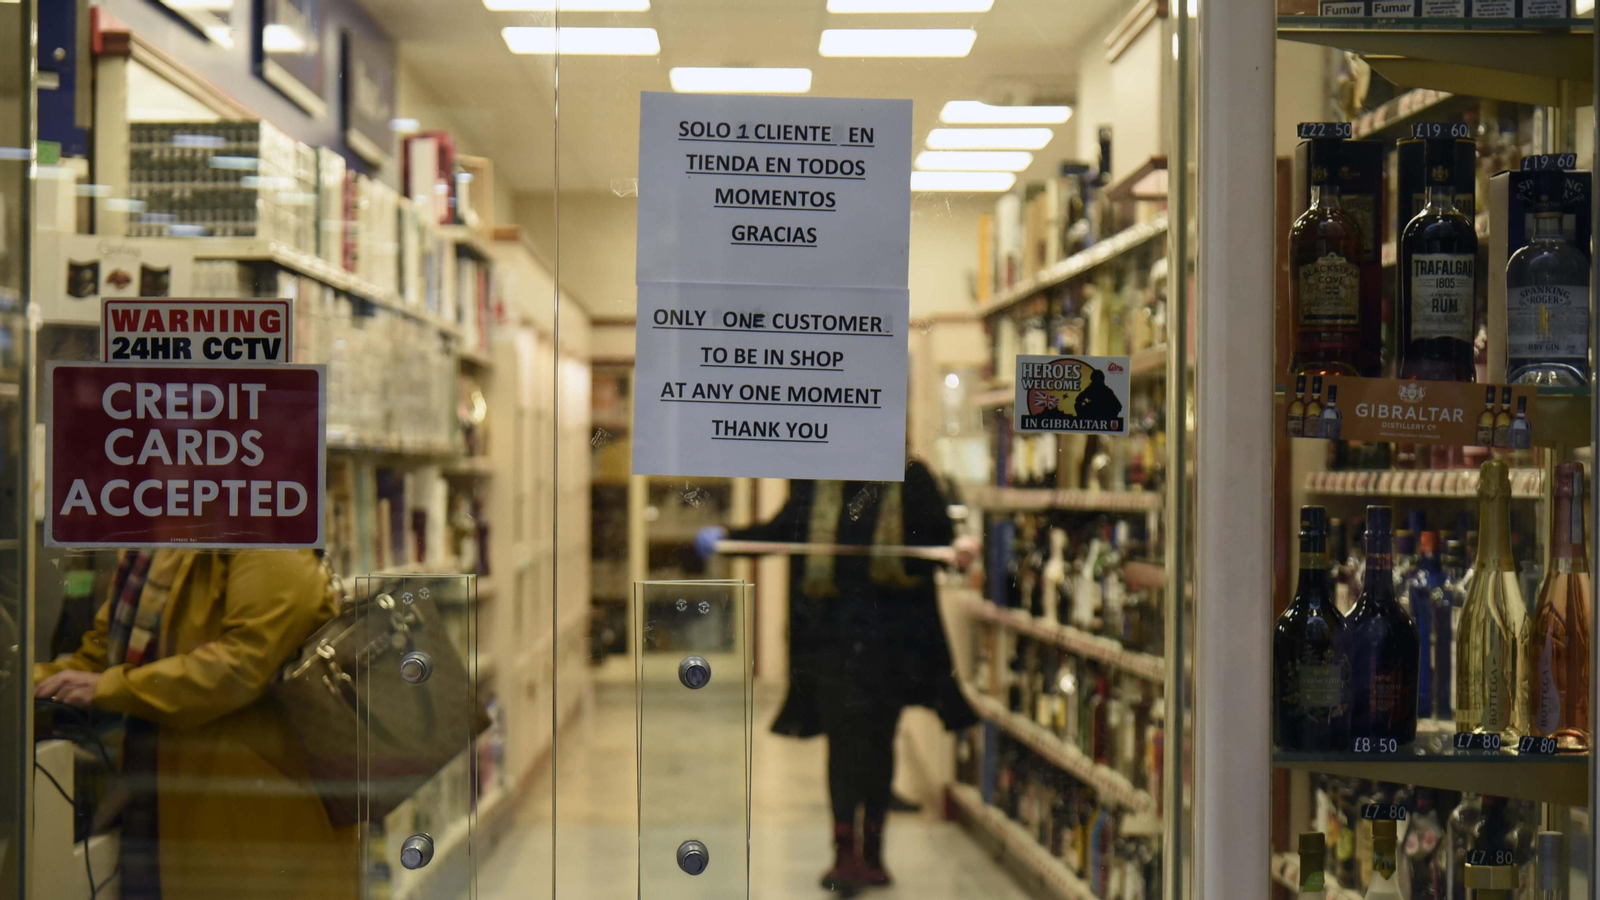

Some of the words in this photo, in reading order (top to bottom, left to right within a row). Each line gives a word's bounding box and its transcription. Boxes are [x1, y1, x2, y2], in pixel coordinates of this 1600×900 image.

[1325, 5, 1362, 15] Fumar
[1374, 3, 1411, 13] Fumar
[679, 120, 731, 138] SOLO
[736, 124, 750, 139] 1
[754, 124, 831, 142] CLIENTE
[849, 127, 874, 143] EN
[686, 154, 759, 172] TIENDA
[766, 156, 791, 173] EN
[797, 158, 866, 176] TODOS
[715, 188, 836, 208] MOMENTOS
[731, 225, 817, 243] GRACIAS
[1414, 260, 1473, 278] TRAFALGAR
[1318, 276, 1345, 284] COVE
[1436, 278, 1455, 288] 1805
[1520, 285, 1570, 299] SPANKING
[1530, 295, 1559, 304] ROGER
[1432, 298, 1458, 313] RUM
[111, 308, 281, 333] WARNING
[653, 309, 707, 326] ONLY
[723, 311, 766, 328] ONE
[772, 313, 882, 333] CUSTOMER
[112, 337, 192, 360] 24HR
[203, 337, 281, 360] CCTV
[700, 347, 728, 364] TO
[734, 348, 757, 365] BE
[764, 349, 784, 365] IN
[790, 350, 844, 367] SHOP
[1022, 363, 1081, 379] HEROES
[660, 382, 687, 398] AT
[692, 383, 733, 400] ANY
[739, 384, 781, 402] ONE
[788, 386, 882, 405] MOMENT
[1021, 379, 1081, 391] WELCOME
[102, 382, 266, 420] CREDIT
[1355, 403, 1464, 422] GIBRALTAR
[712, 420, 780, 438] THANK
[786, 422, 828, 439] YOU
[1025, 418, 1038, 428] IN
[1041, 418, 1108, 430] GIBRALTAR
[1382, 421, 1425, 430] DISTILLERY
[104, 428, 265, 467] CARDS
[59, 478, 308, 517] ACCEPTED
[1489, 669, 1498, 726] BOTTEGA
[1541, 670, 1549, 727] BOTTEGA
